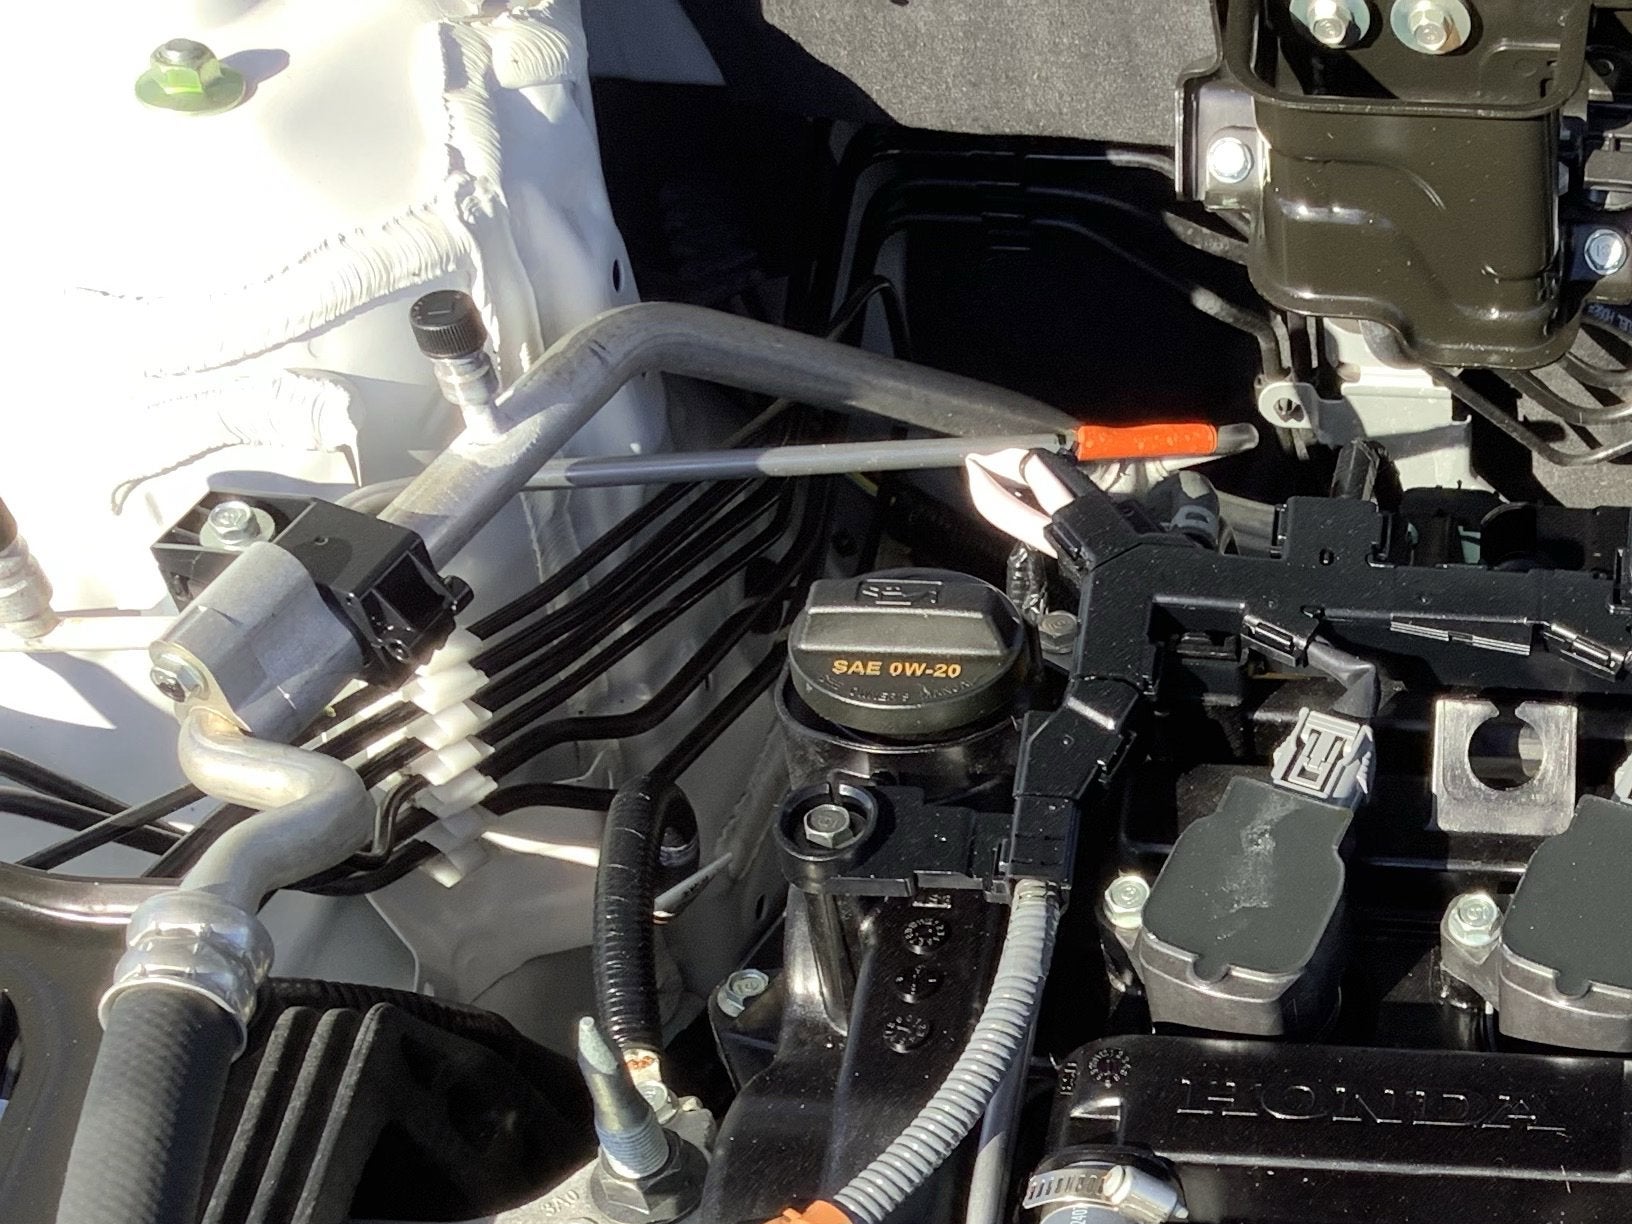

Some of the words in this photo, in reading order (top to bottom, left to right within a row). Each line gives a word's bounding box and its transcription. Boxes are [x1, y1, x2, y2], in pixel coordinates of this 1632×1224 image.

[831, 659, 883, 677] SAE
[888, 661, 963, 679] 0W-20
[1176, 1079, 1567, 1131] HONDA
